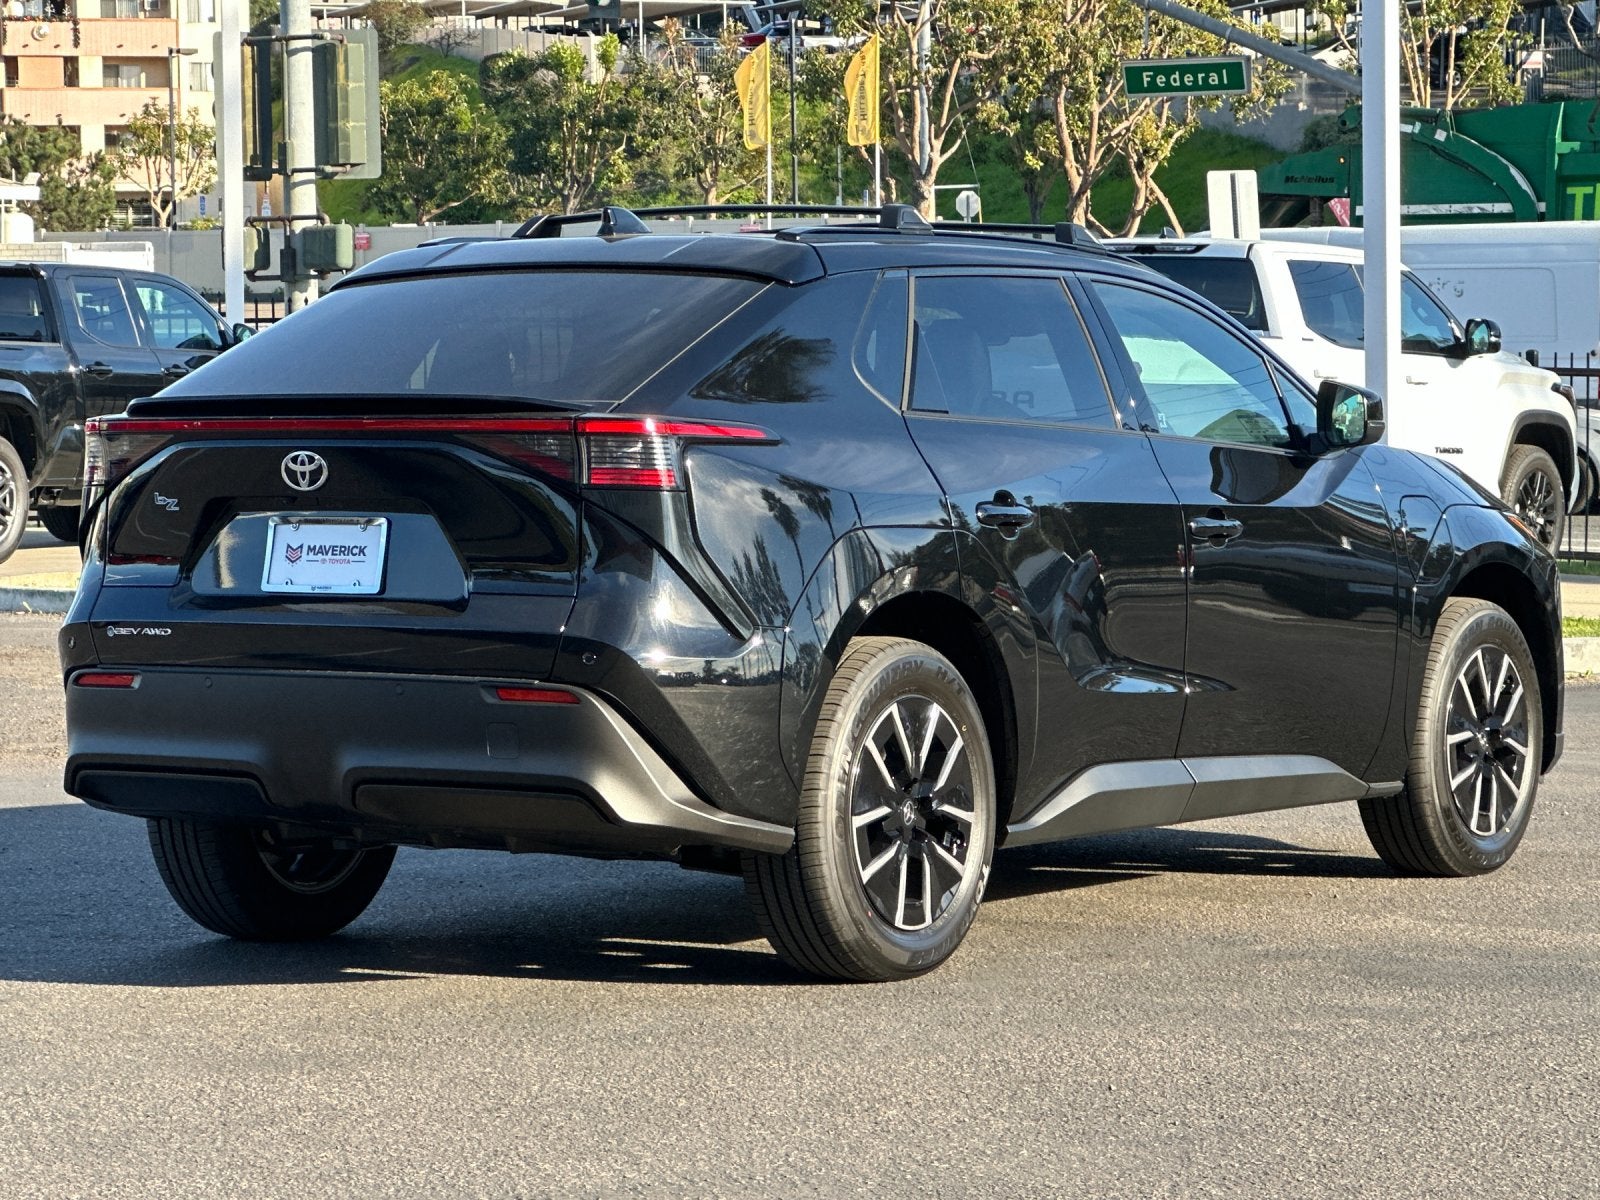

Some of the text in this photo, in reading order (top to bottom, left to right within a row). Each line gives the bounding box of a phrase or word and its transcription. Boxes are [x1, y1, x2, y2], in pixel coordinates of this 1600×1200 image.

[1142, 69, 1228, 88] Federal
[306, 544, 368, 557] MAVERICK
[141, 627, 172, 636] AWD
